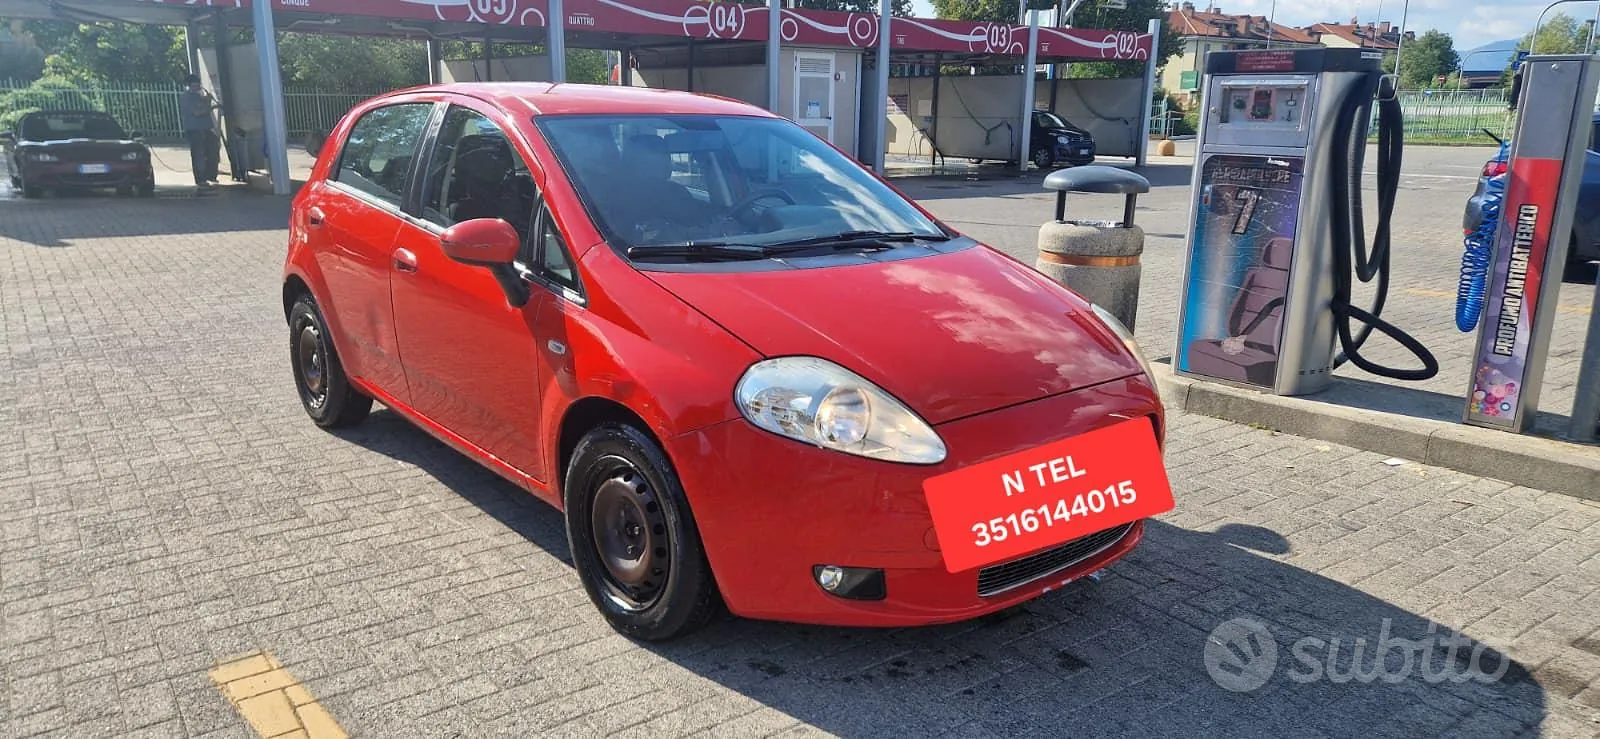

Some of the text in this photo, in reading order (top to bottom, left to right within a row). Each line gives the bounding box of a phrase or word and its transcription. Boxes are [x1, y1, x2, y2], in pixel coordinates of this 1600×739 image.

[568, 15, 596, 26] QUATTRO
[715, 5, 738, 32] 04
[990, 25, 1007, 47] 03
[1119, 33, 1134, 53] 02
[1232, 186, 1261, 235] 7
[1494, 204, 1538, 356] PROFUMO ANTIBATTERICO
